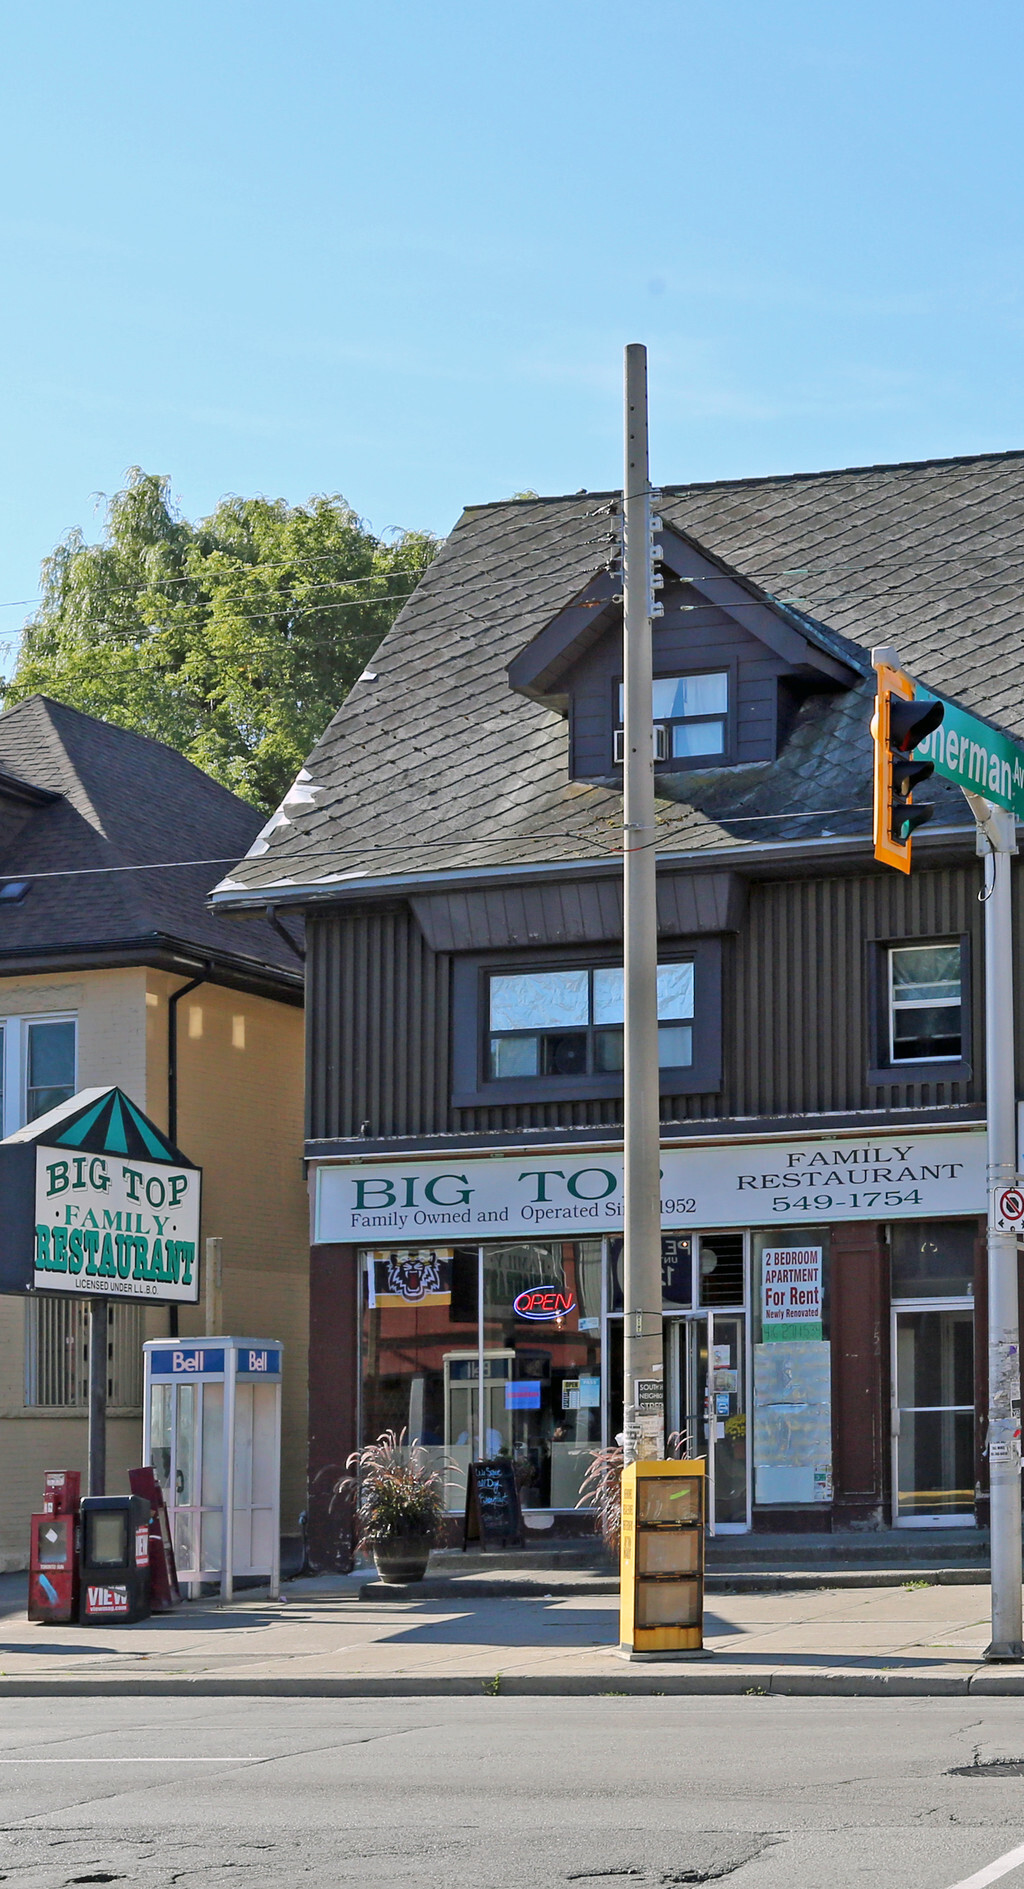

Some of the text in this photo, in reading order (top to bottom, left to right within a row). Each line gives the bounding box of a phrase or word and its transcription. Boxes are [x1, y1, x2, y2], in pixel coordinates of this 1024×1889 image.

[916, 720, 1012, 800] herman
[786, 1146, 915, 1168] FAMILY
[46, 1157, 188, 1208] BIG TOP
[736, 1163, 963, 1190] RESTAURANT
[350, 1167, 663, 1210] BIG TO
[772, 1189, 923, 1212] 549-1754
[64, 1204, 171, 1236] FAMILY
[351, 1210, 408, 1230] Family
[413, 1209, 471, 1226] Owned
[478, 1207, 509, 1222] and
[521, 1203, 599, 1223] Operated
[659, 1198, 697, 1214] 1952
[35, 1224, 195, 1286] RESTAURANT
[766, 1250, 818, 1266] 2 BEDROOM
[75, 1279, 109, 1291] LICENSED
[110, 1281, 133, 1293] UNDER
[765, 1268, 819, 1283] APARTMENT
[515, 1292, 574, 1312] OPEN
[765, 1286, 819, 1306] For Rent
[765, 1308, 819, 1320] Newly Renovated
[172, 1351, 204, 1372] Bell
[249, 1351, 267, 1372] Bell
[88, 1587, 128, 1606] VIEW
